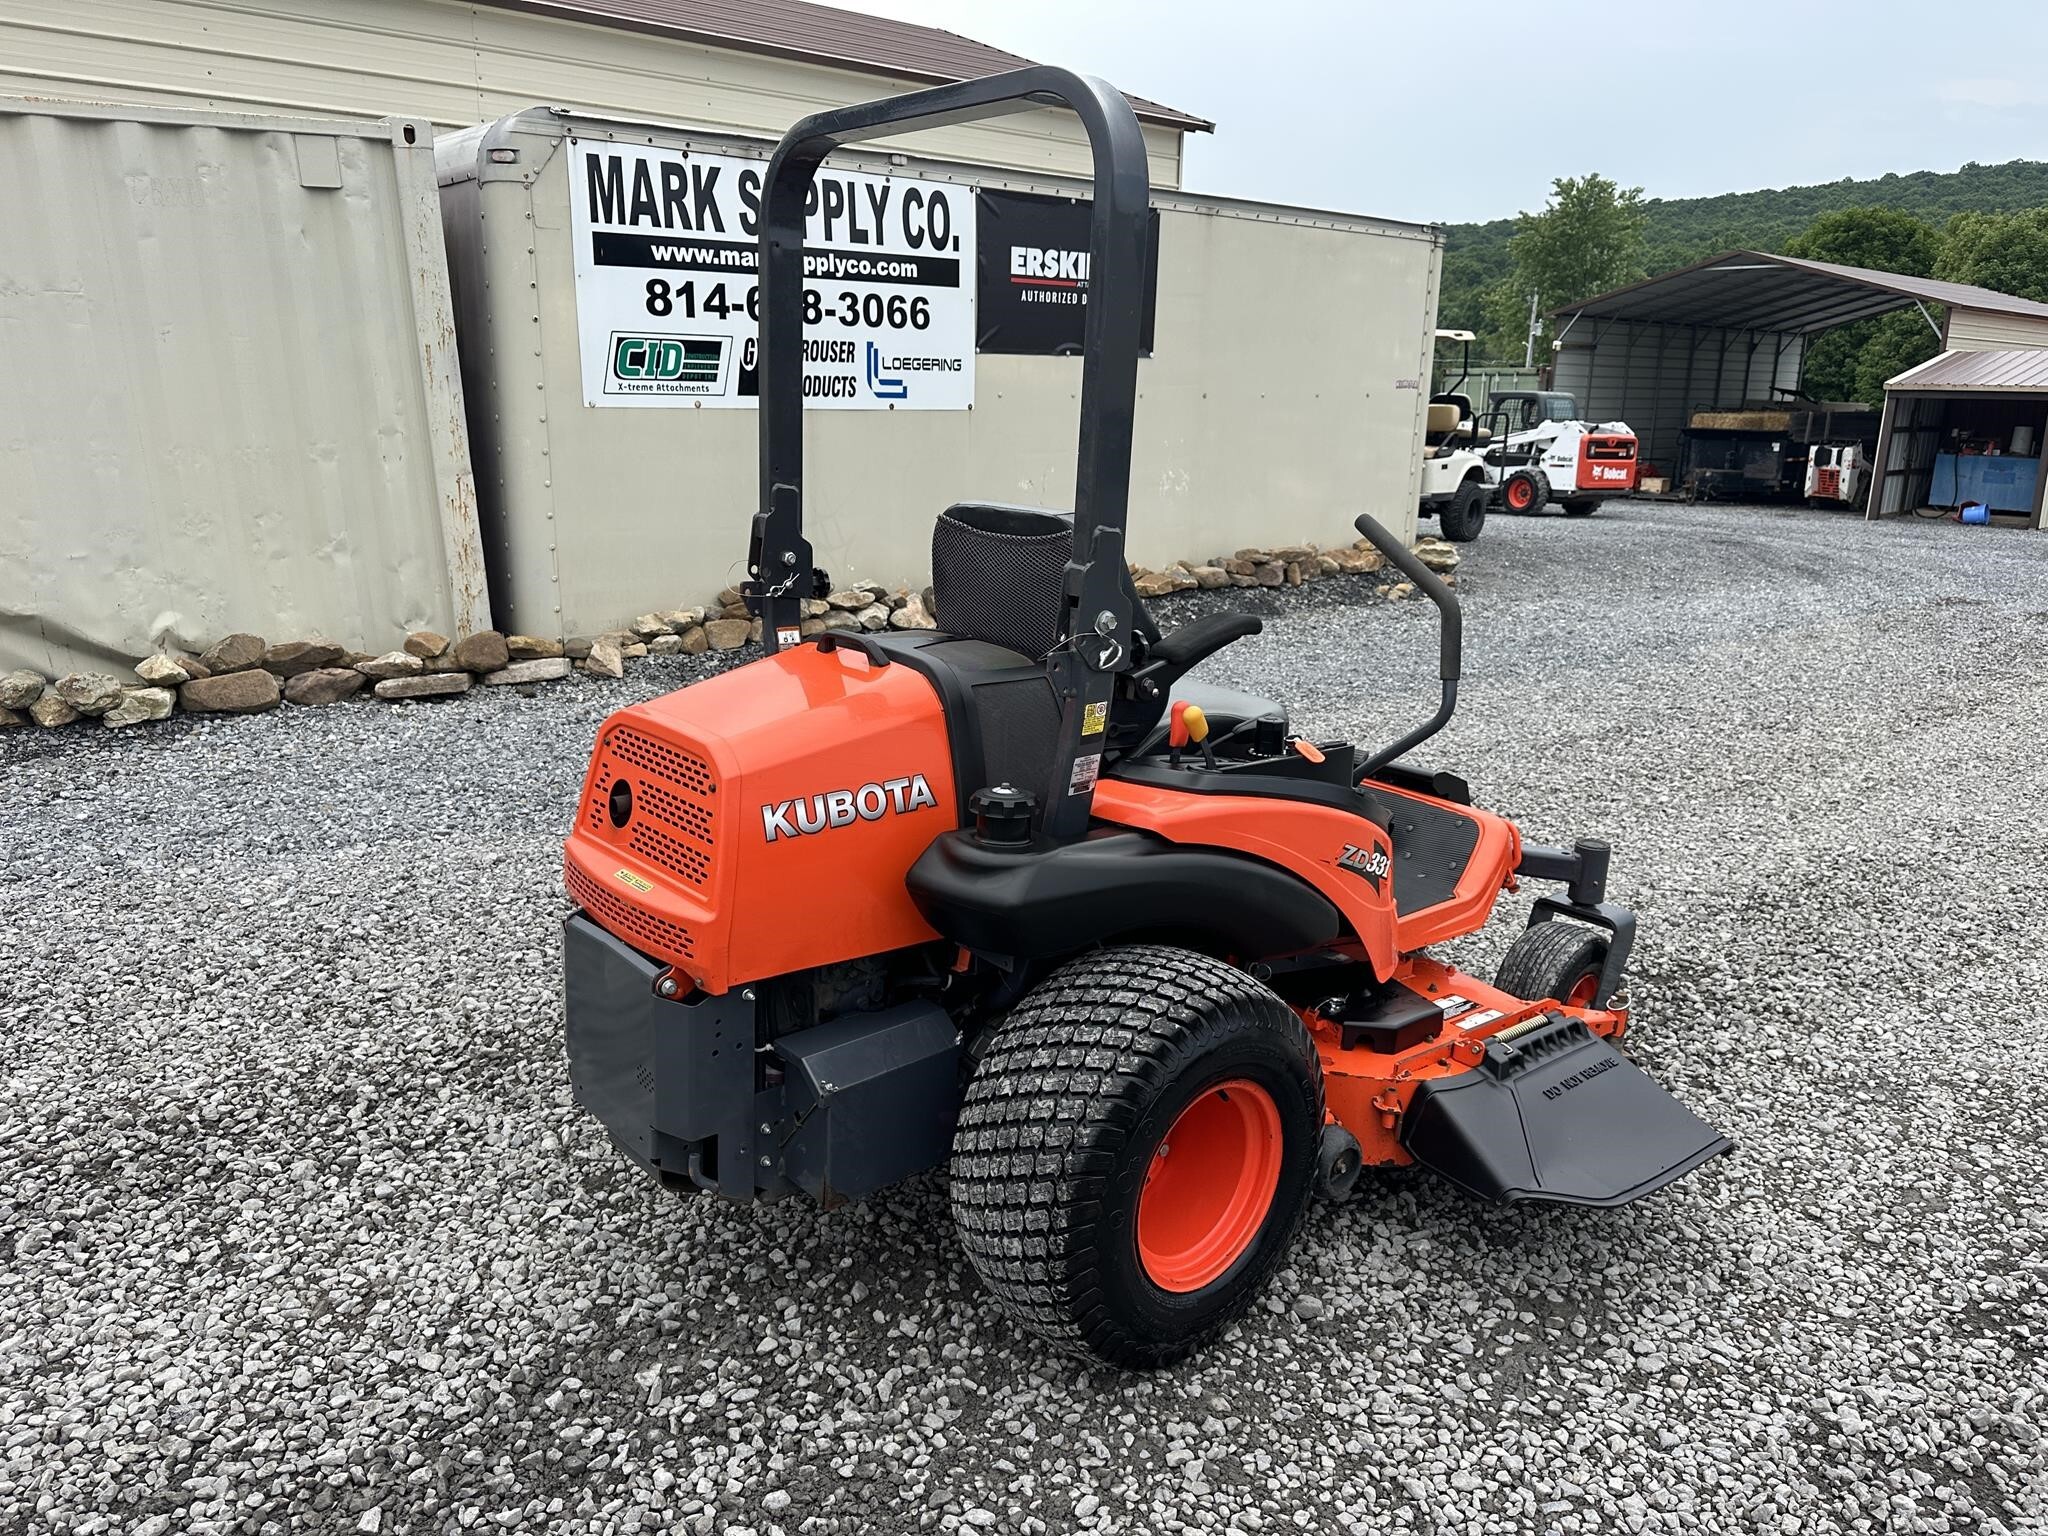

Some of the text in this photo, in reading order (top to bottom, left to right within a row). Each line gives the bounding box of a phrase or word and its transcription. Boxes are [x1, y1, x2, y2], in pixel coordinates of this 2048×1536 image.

[586, 153, 960, 252] MARK SPPLY CO.
[645, 278, 931, 330] 814-68-3066
[1020, 289, 1078, 305] AUTHORIZED
[617, 338, 685, 380] CID
[882, 355, 963, 372] LOEGERING
[618, 382, 710, 393] X-treme Attachments
[802, 374, 857, 398] ODUCTS
[1603, 467, 1628, 480] Bobcat
[761, 774, 937, 843] KUBOTA
[1542, 1057, 1620, 1101] DO NOT REMOVE
